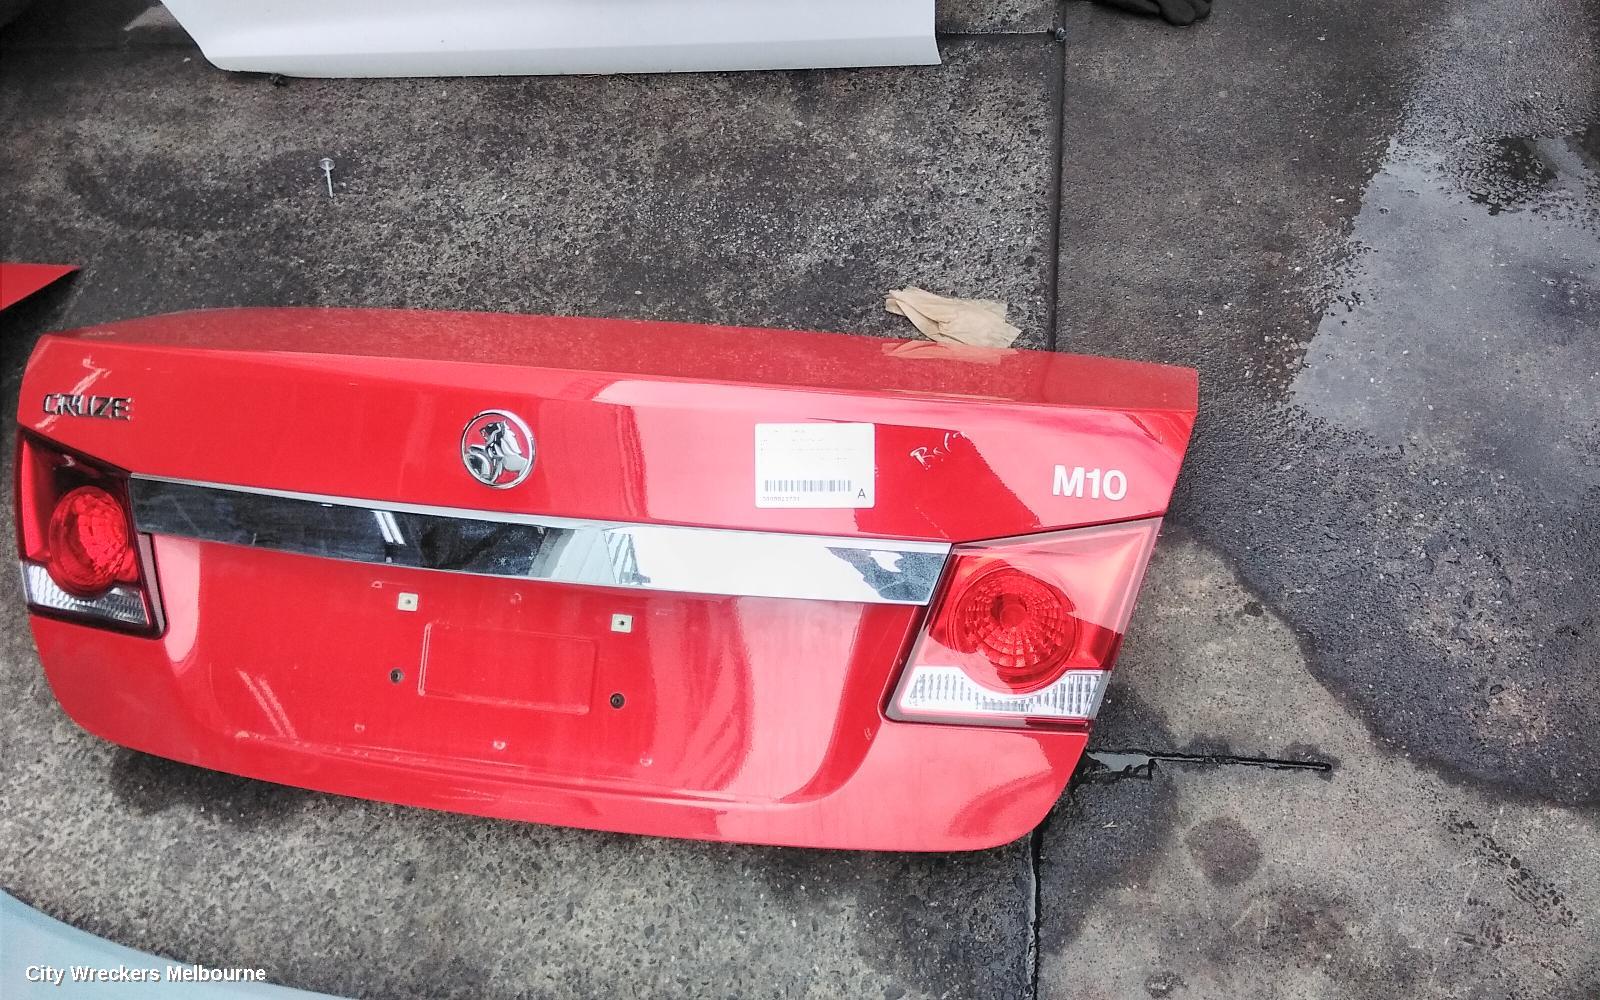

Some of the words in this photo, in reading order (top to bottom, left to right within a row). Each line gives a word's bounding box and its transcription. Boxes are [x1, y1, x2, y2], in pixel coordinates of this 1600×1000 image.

[43, 393, 132, 421] CRUZE
[857, 488, 867, 499] A
[1052, 465, 1127, 501] M10
